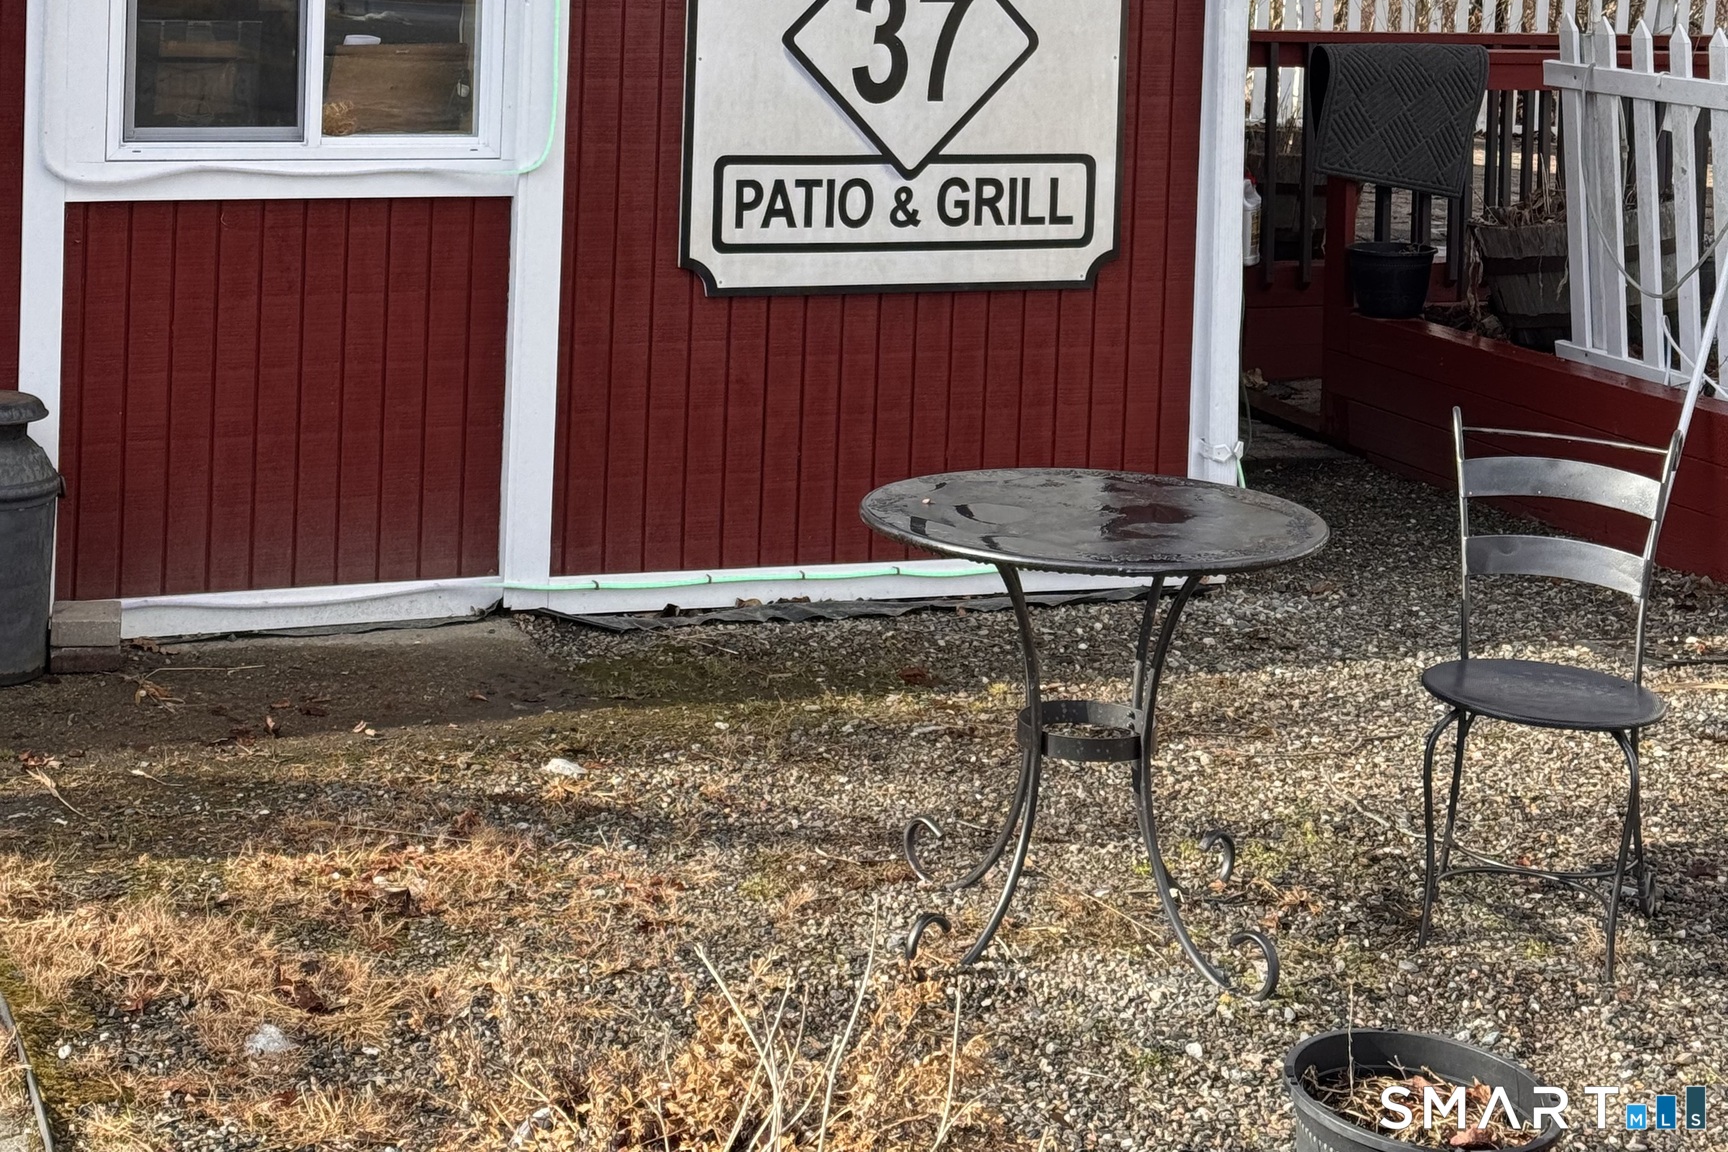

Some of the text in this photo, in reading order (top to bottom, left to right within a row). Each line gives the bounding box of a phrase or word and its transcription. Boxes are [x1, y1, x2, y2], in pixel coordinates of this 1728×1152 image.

[734, 176, 1075, 230] PATIO & GRILL
